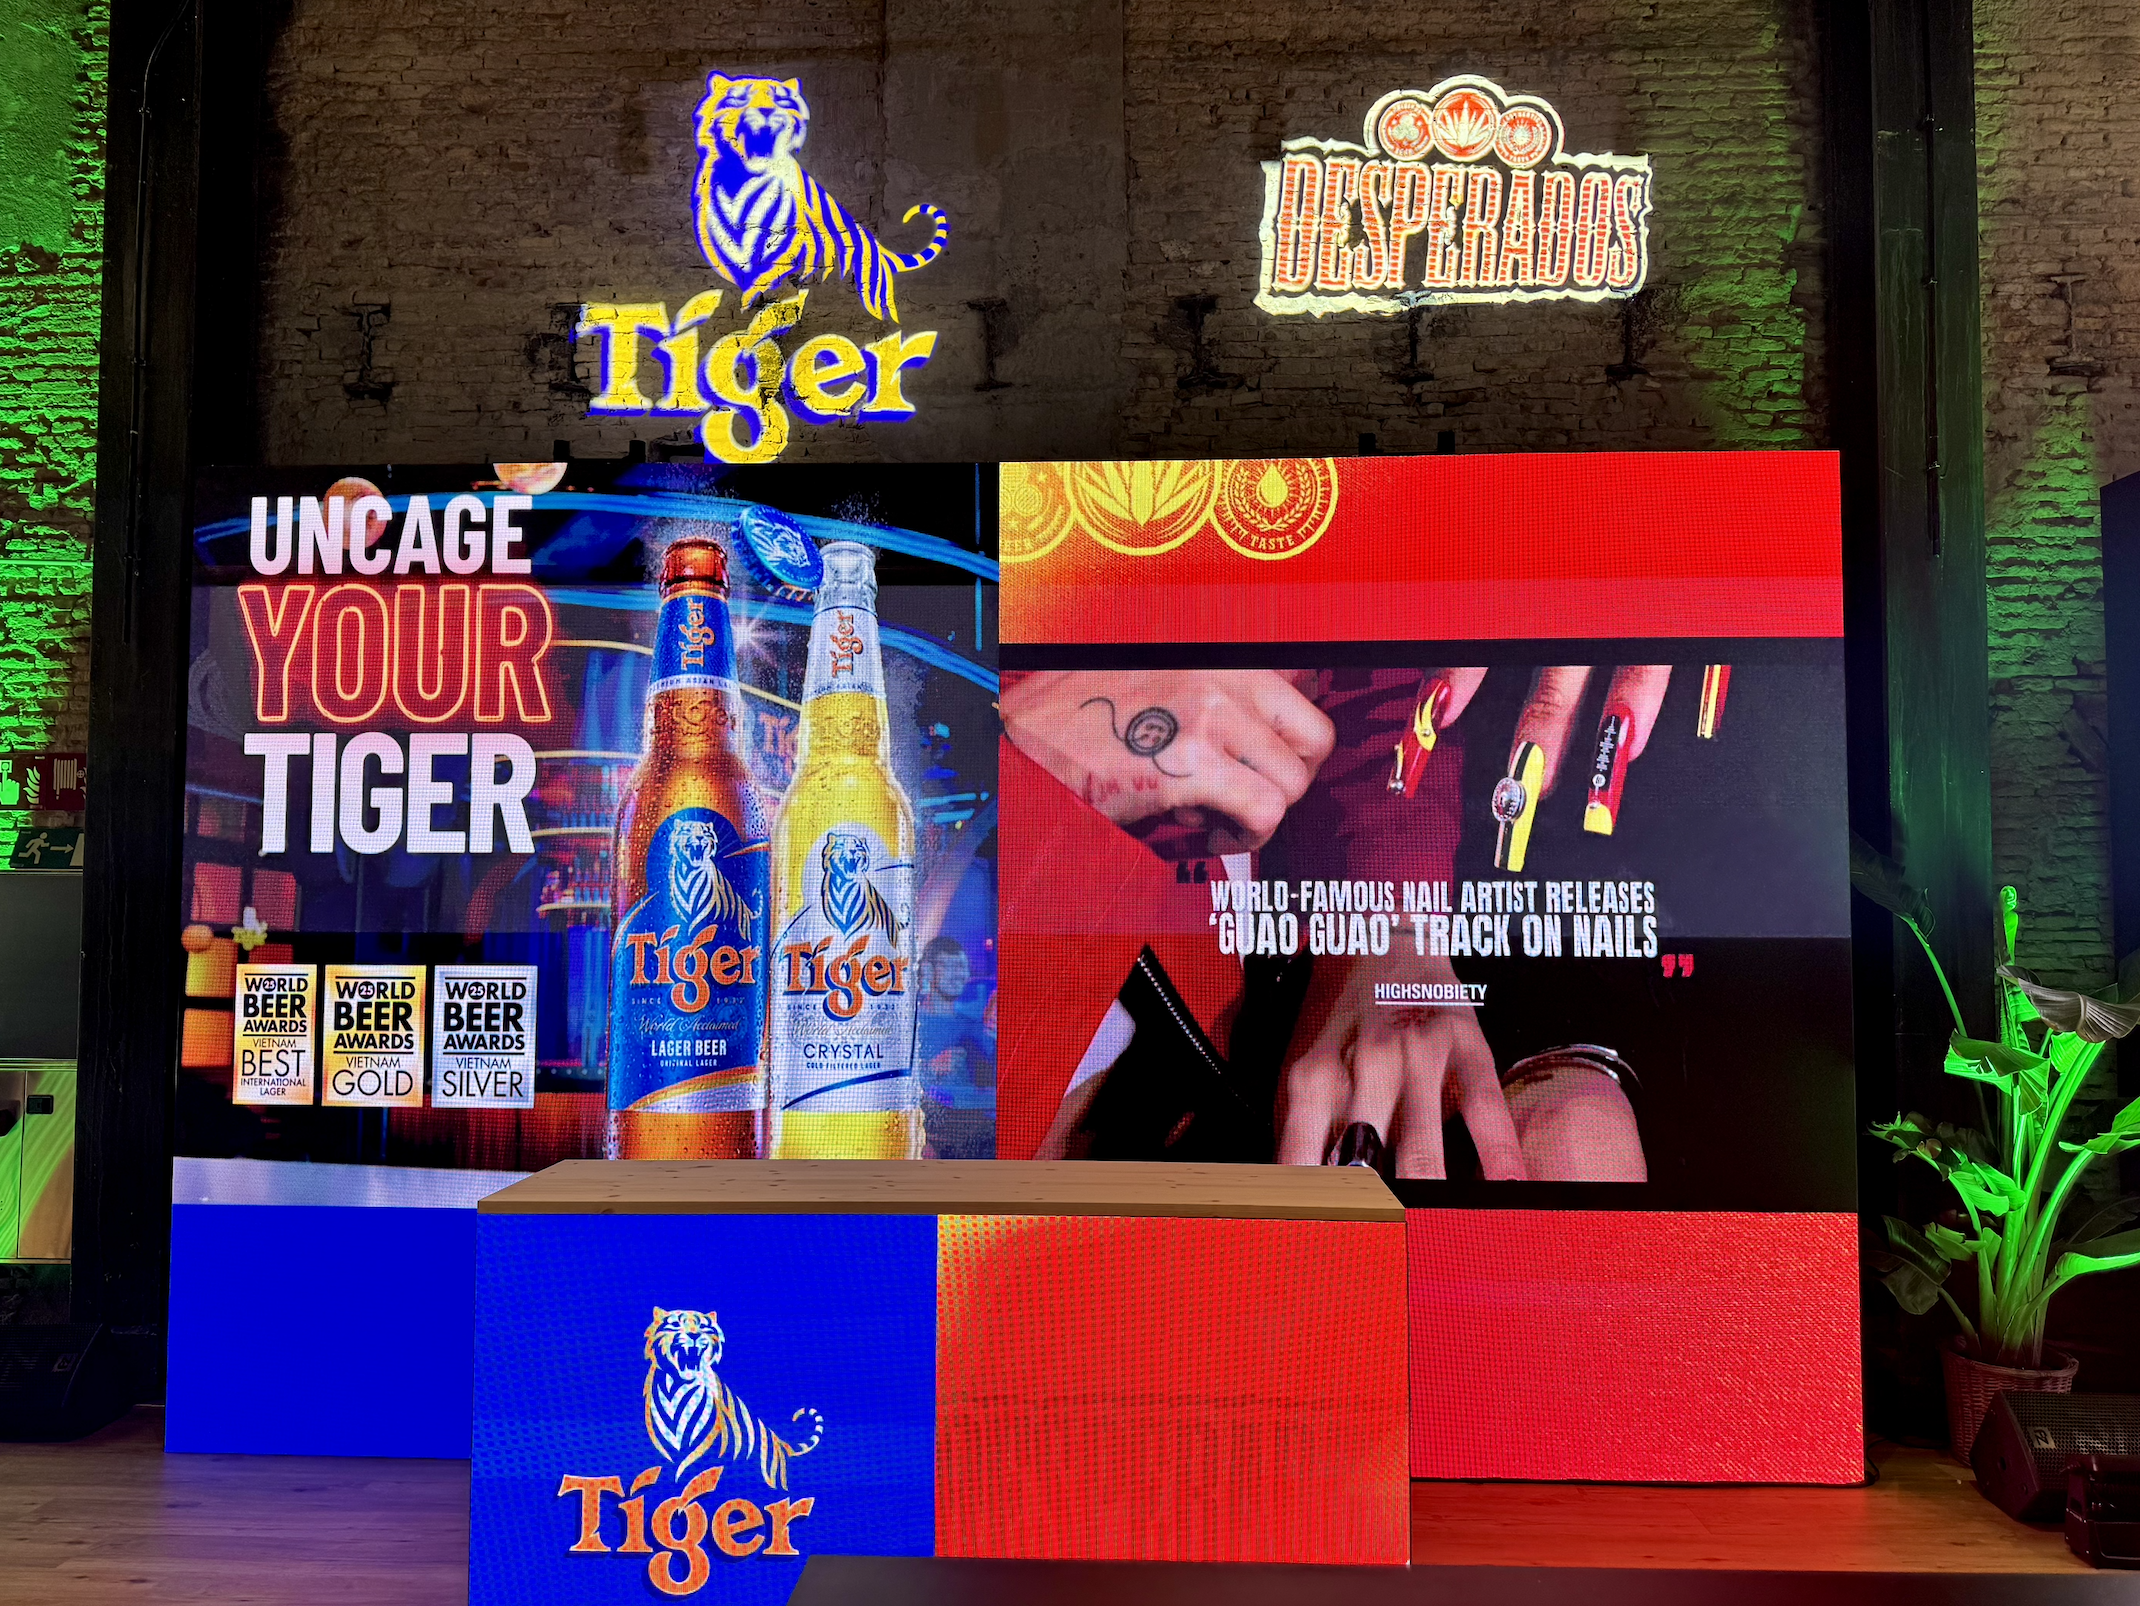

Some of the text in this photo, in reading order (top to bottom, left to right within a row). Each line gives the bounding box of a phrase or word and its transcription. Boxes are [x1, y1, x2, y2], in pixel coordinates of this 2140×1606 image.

[1271, 152, 1644, 292] DESPERADOS
[572, 288, 938, 464] Tiger
[249, 494, 533, 575] UNCAGE
[1249, 536, 1296, 551] TASTE
[679, 598, 715, 671] Tiger
[830, 610, 864, 679] Tiger
[237, 582, 552, 723] YOUR
[243, 731, 536, 854] TIGER
[1210, 880, 1655, 914] WORLD-FAMOUS NAIL ARTIST RELEASES
[1410, 913, 1511, 957] TRACK
[1521, 914, 1563, 958] ON
[1573, 914, 1659, 958] NAILS
[625, 923, 761, 1014] Tiger
[782, 934, 910, 1022] Tiger
[1374, 983, 1488, 1001] HIGHSNOBIETY
[243, 994, 307, 1018] BEER
[333, 1001, 414, 1032] BEER
[443, 1002, 524, 1032] BEER
[243, 1019, 307, 1033] AWARDS
[638, 1015, 675, 1033] World
[253, 1037, 297, 1048] VIETNAM
[333, 1033, 414, 1049] AWARDS
[442, 1034, 526, 1051] AWARDS
[651, 1039, 727, 1057] LAGER BEER
[803, 1043, 884, 1059] CRYSTAL
[241, 1049, 306, 1077] BEST
[345, 1056, 401, 1068] VIETNAM
[455, 1057, 512, 1070] VIETNAM
[659, 1058, 718, 1068] ORIGINAL LAGER
[240, 1077, 307, 1088] INTERNATIONAL
[259, 1086, 287, 1096] LAGER
[332, 1069, 414, 1096] GOLD
[442, 1071, 524, 1098] SILVER
[557, 1465, 816, 1597] Tiger
